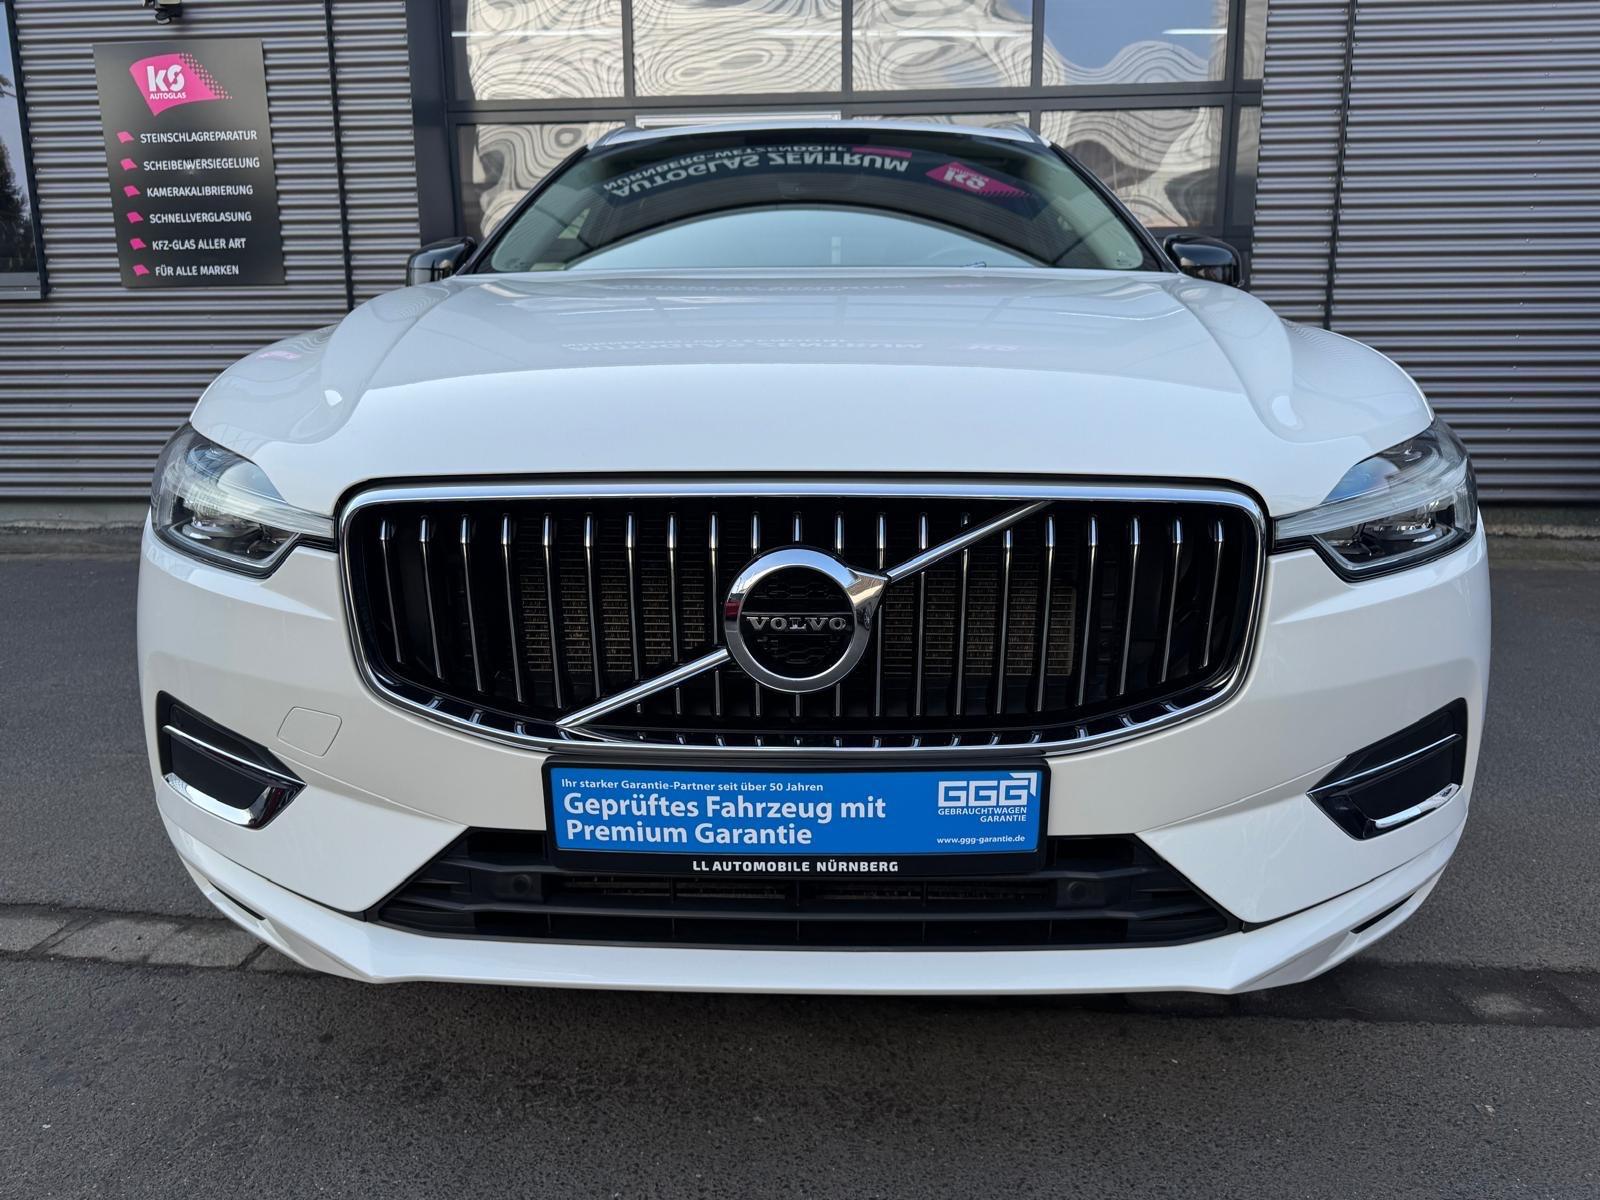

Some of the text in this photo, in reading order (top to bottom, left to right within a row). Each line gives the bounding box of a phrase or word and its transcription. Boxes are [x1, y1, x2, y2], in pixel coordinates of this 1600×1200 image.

[150, 92, 186, 100] AUTOGLAS
[140, 130, 257, 144] STEINSCHLAGREPARATUR
[143, 157, 260, 171] SCHEIBENVERSIEGELUNG
[146, 184, 254, 198] KAMERAKALIBRIERUNG
[149, 211, 252, 224] SCHNELLVERGLASUNG
[152, 237, 246, 251] KFZ-GLAS ALLER ART
[155, 264, 239, 276] FÜR ALLE MARKEN
[746, 616, 847, 631] VOLVO
[561, 778, 823, 791] Ihr starker Garantie-Partner seit über 50 Jahren
[938, 779, 1029, 807] GGG
[563, 792, 886, 824] Geprüftes Fahrzeug mit
[938, 807, 1027, 815] GEBRAUCHTWAGEN
[980, 814, 1027, 822] GARANTIE
[566, 819, 812, 844] Premium Garantie
[936, 835, 1025, 844] www.ggg-garantie.de
[692, 859, 898, 872] LL AUTOMOBILE NÜRNBERG
